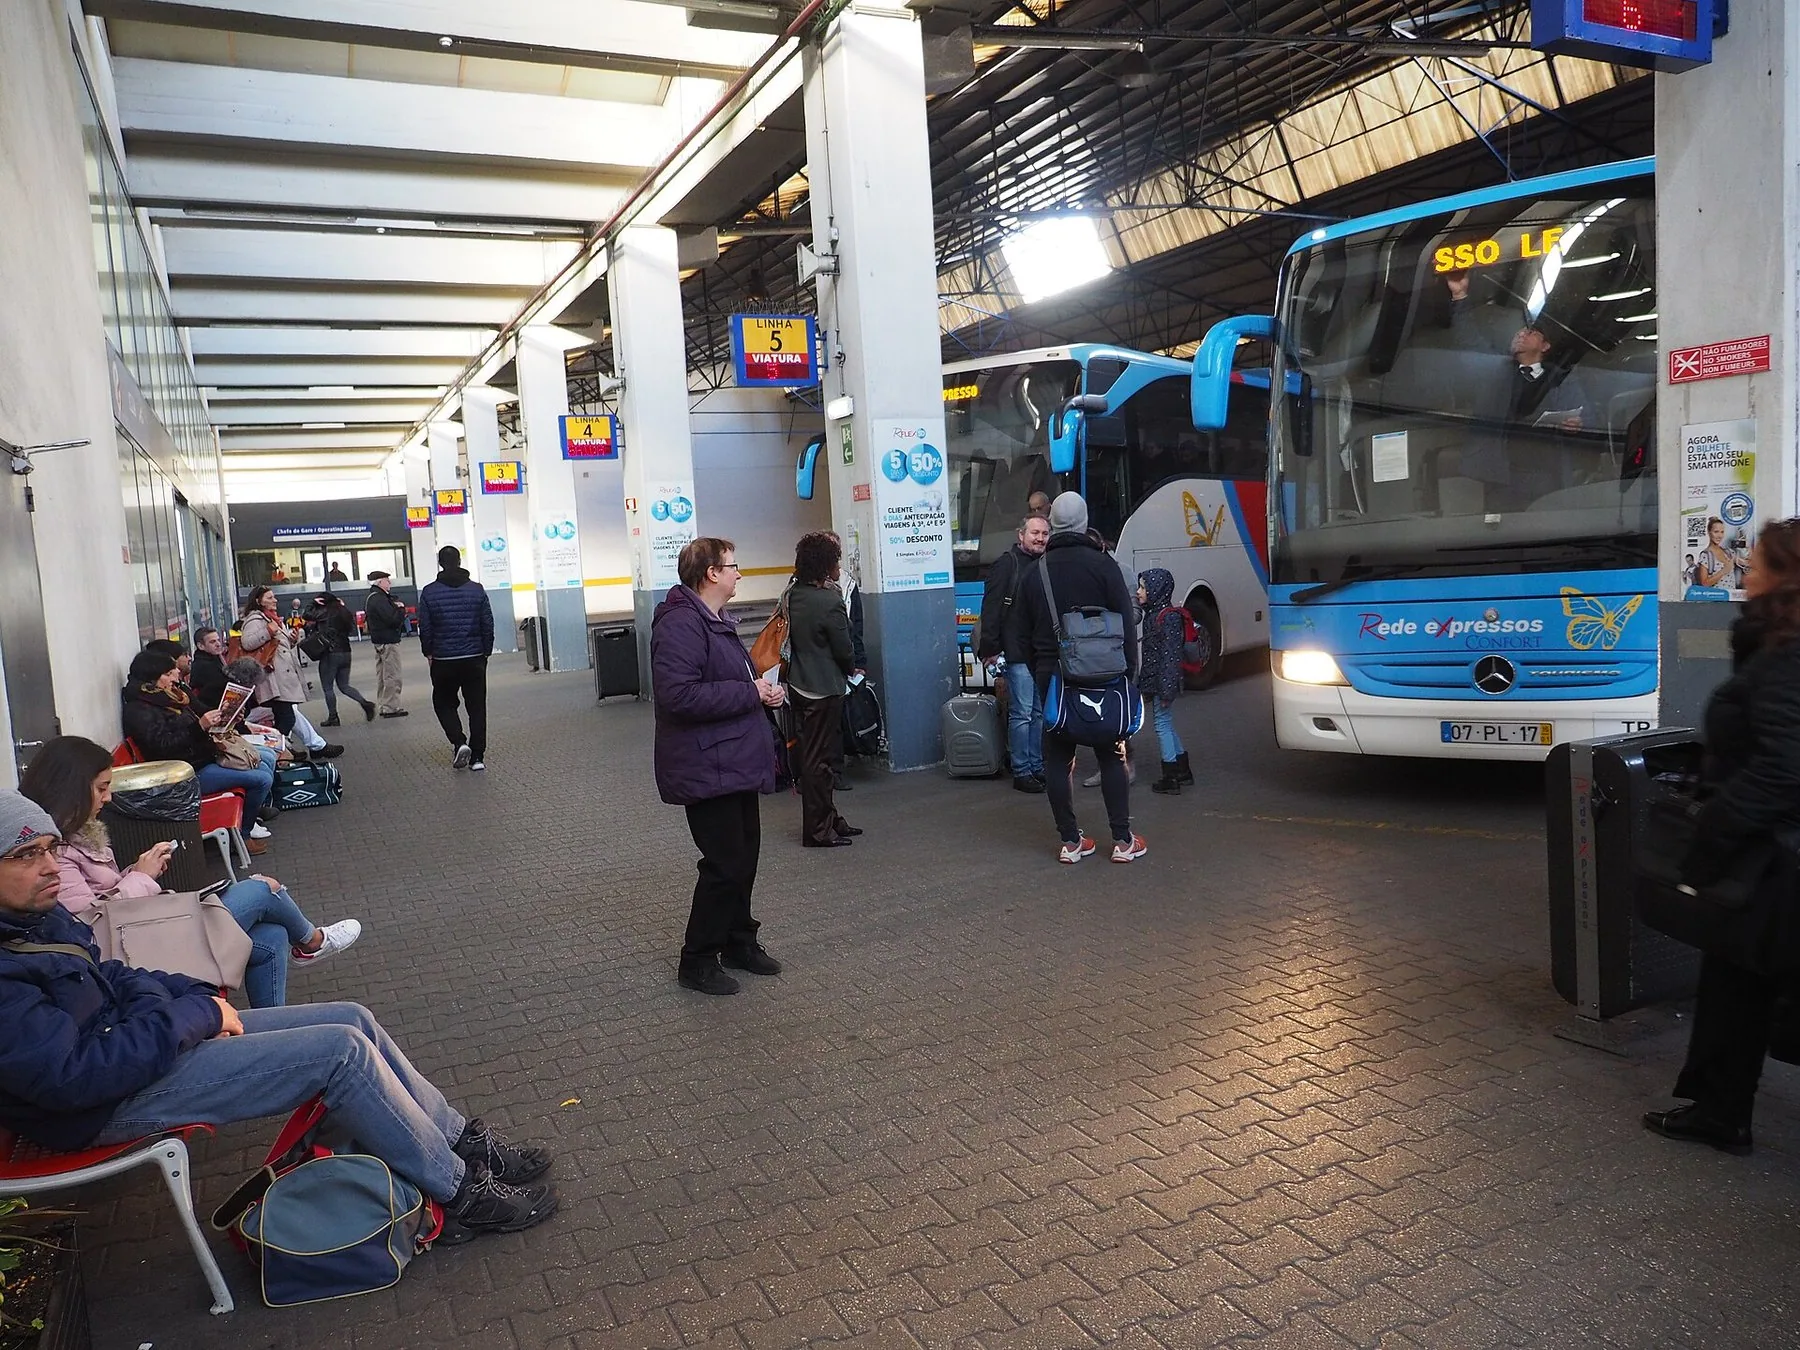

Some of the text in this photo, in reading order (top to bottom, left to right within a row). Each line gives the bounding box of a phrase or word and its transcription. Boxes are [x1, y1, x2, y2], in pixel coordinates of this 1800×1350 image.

[1434, 239, 1500, 272] SSO
[756, 319, 793, 329] LINHA
[769, 330, 782, 352] 5
[1703, 339, 1768, 356] NÃO FUMADORES
[752, 353, 802, 363] VIATURA
[1703, 351, 1752, 365] NO SMOKERS
[1703, 360, 1756, 374] NON FUMEURS
[583, 424, 593, 438] 4
[572, 438, 607, 446] VIATURA
[1687, 435, 1719, 445] AGORA
[1687, 442, 1731, 454] O BILHETE
[1710, 451, 1724, 461] NO
[1726, 450, 1743, 459] SEU
[890, 451, 942, 472] 5 50%
[1687, 457, 1750, 471] SMARTPHONE
[497, 468, 504, 479] 3
[447, 494, 453, 503] 2
[887, 506, 913, 514] CLIENTE
[317, 526, 343, 534] Operating
[344, 525, 366, 533] Manager
[884, 521, 910, 529] VIAGENS
[906, 534, 943, 544] DESCONTO
[1358, 613, 1418, 641] Rede
[1465, 634, 1543, 650] CONFORT
